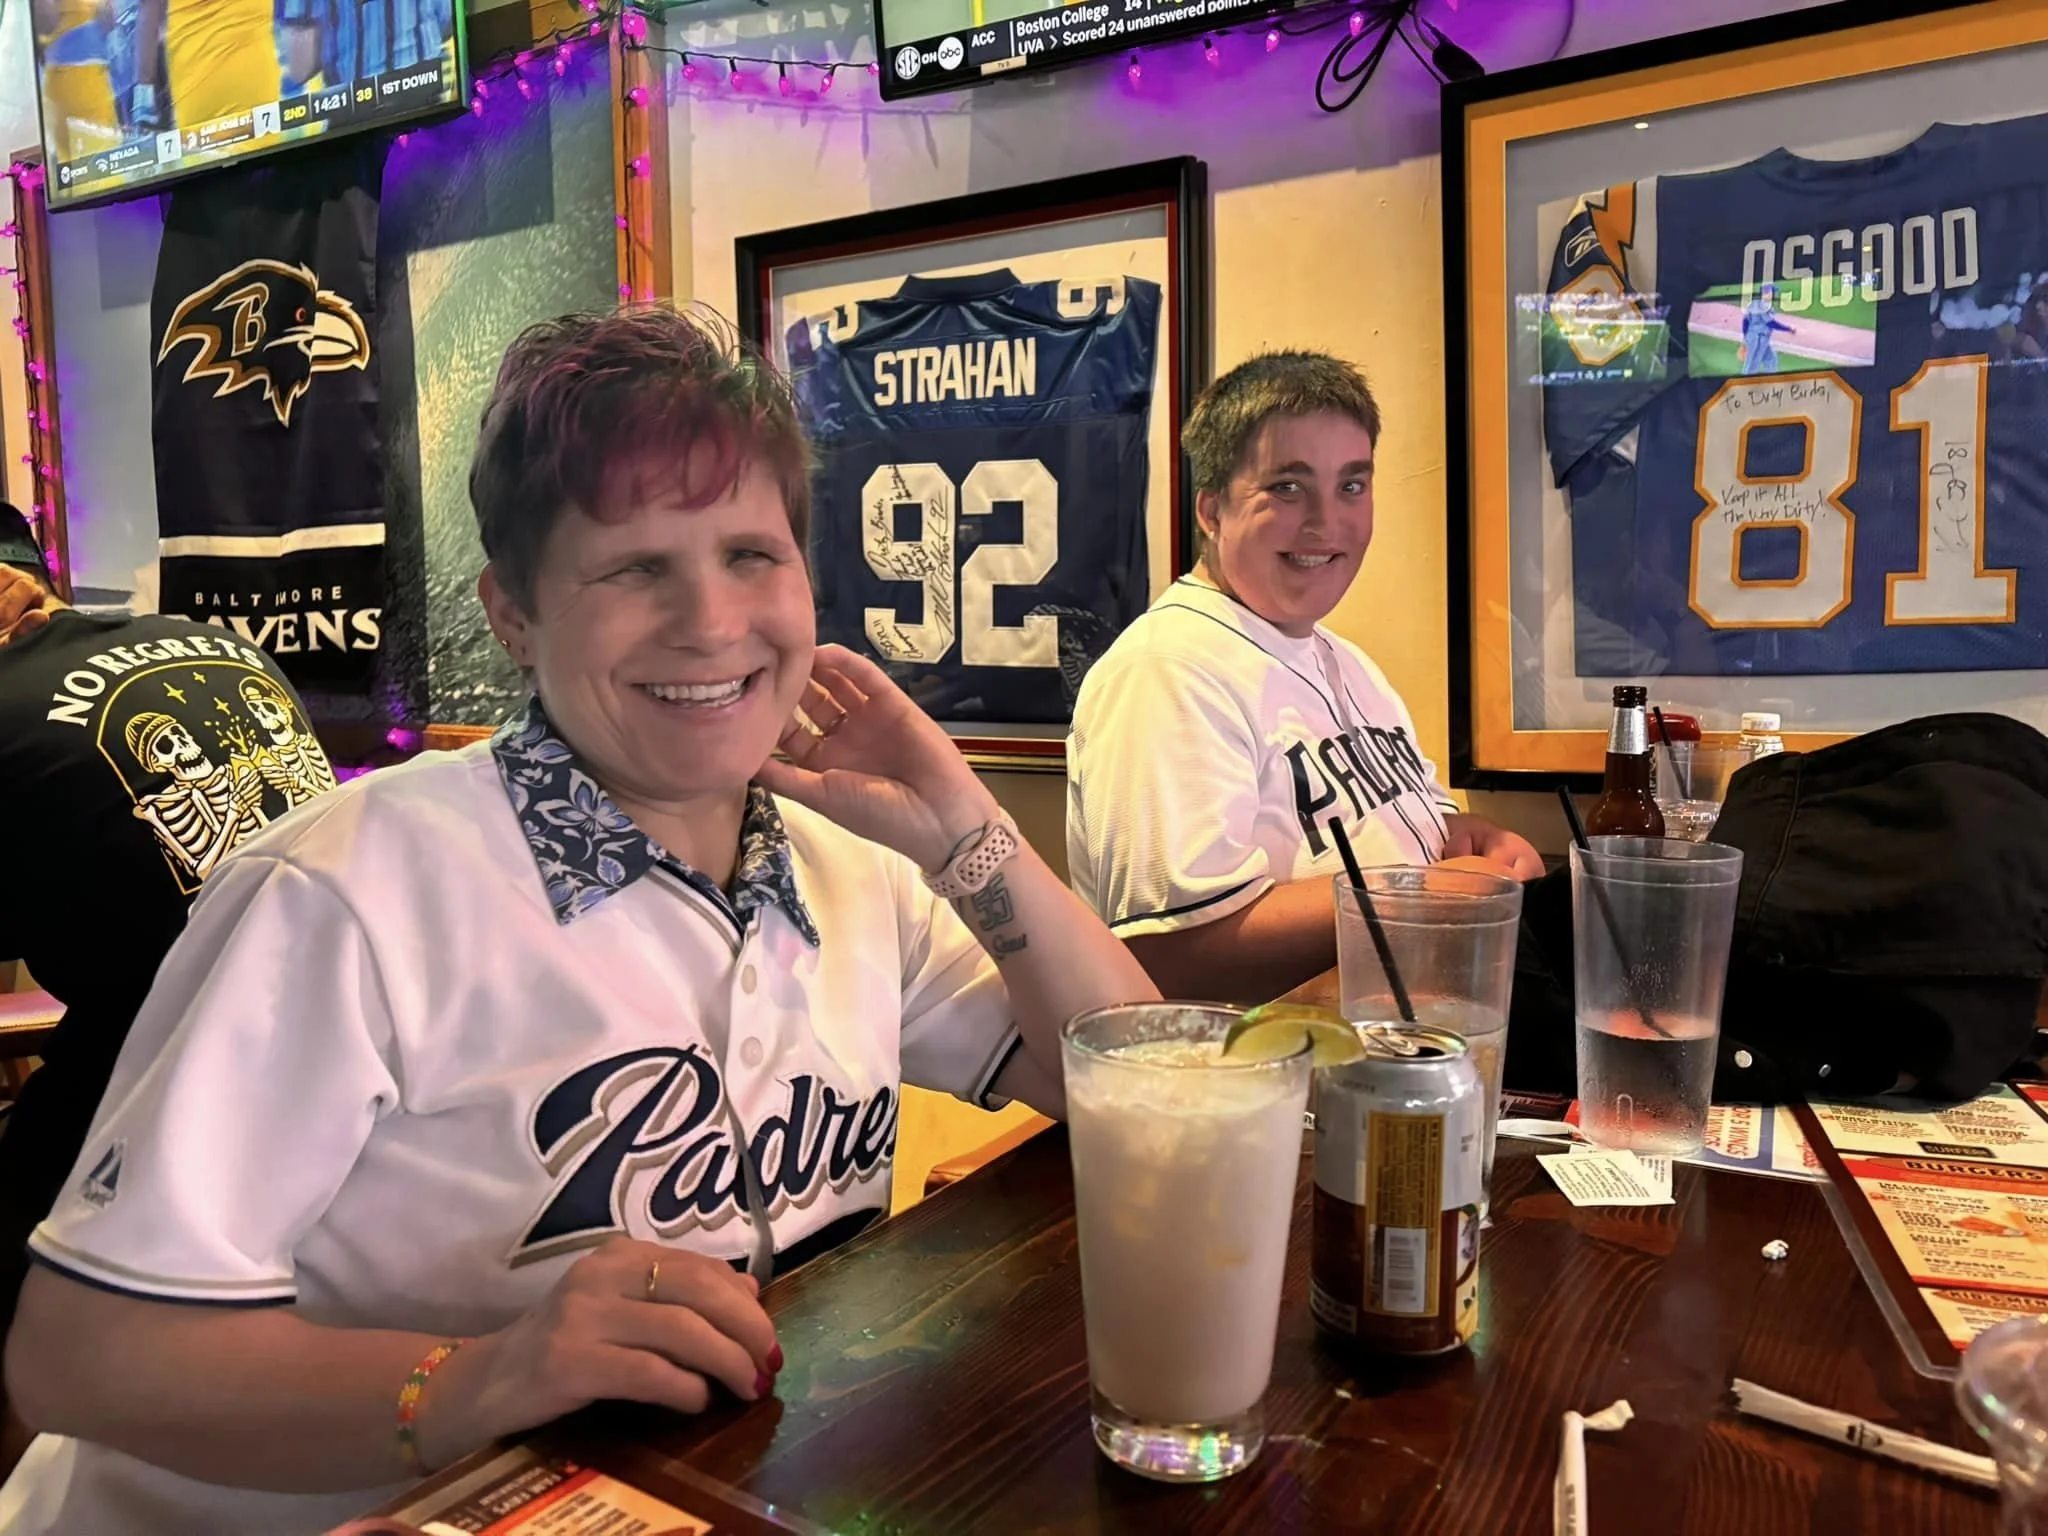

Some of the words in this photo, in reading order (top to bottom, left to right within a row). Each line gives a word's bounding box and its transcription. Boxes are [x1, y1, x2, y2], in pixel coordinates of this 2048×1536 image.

[971, 30, 996, 48] ACC
[1016, 13, 1060, 37] Boston
[1062, 4, 1109, 27] College
[1017, 39, 1044, 56] UVA
[1062, 27, 1106, 47] Scored
[1108, 19, 1125, 37] 24
[1126, 4, 1206, 32] unanswered
[382, 81, 402, 96] 1ST
[402, 70, 438, 91] DOWN
[896, 48, 921, 78] SEC
[261, 110, 271, 129] 7
[283, 105, 306, 122] 2ND
[163, 138, 174, 154] 7
[1741, 206, 1979, 312] OSGOOD
[211, 282, 269, 358] B
[873, 336, 1038, 407] STRAHAN
[1688, 352, 2017, 630] 81
[861, 458, 1060, 668] 92
[165, 607, 382, 654] VENS
[47, 670, 106, 728] NO
[86, 636, 265, 677] REGRETS
[1905, 1160, 2044, 1181] BURGERS
